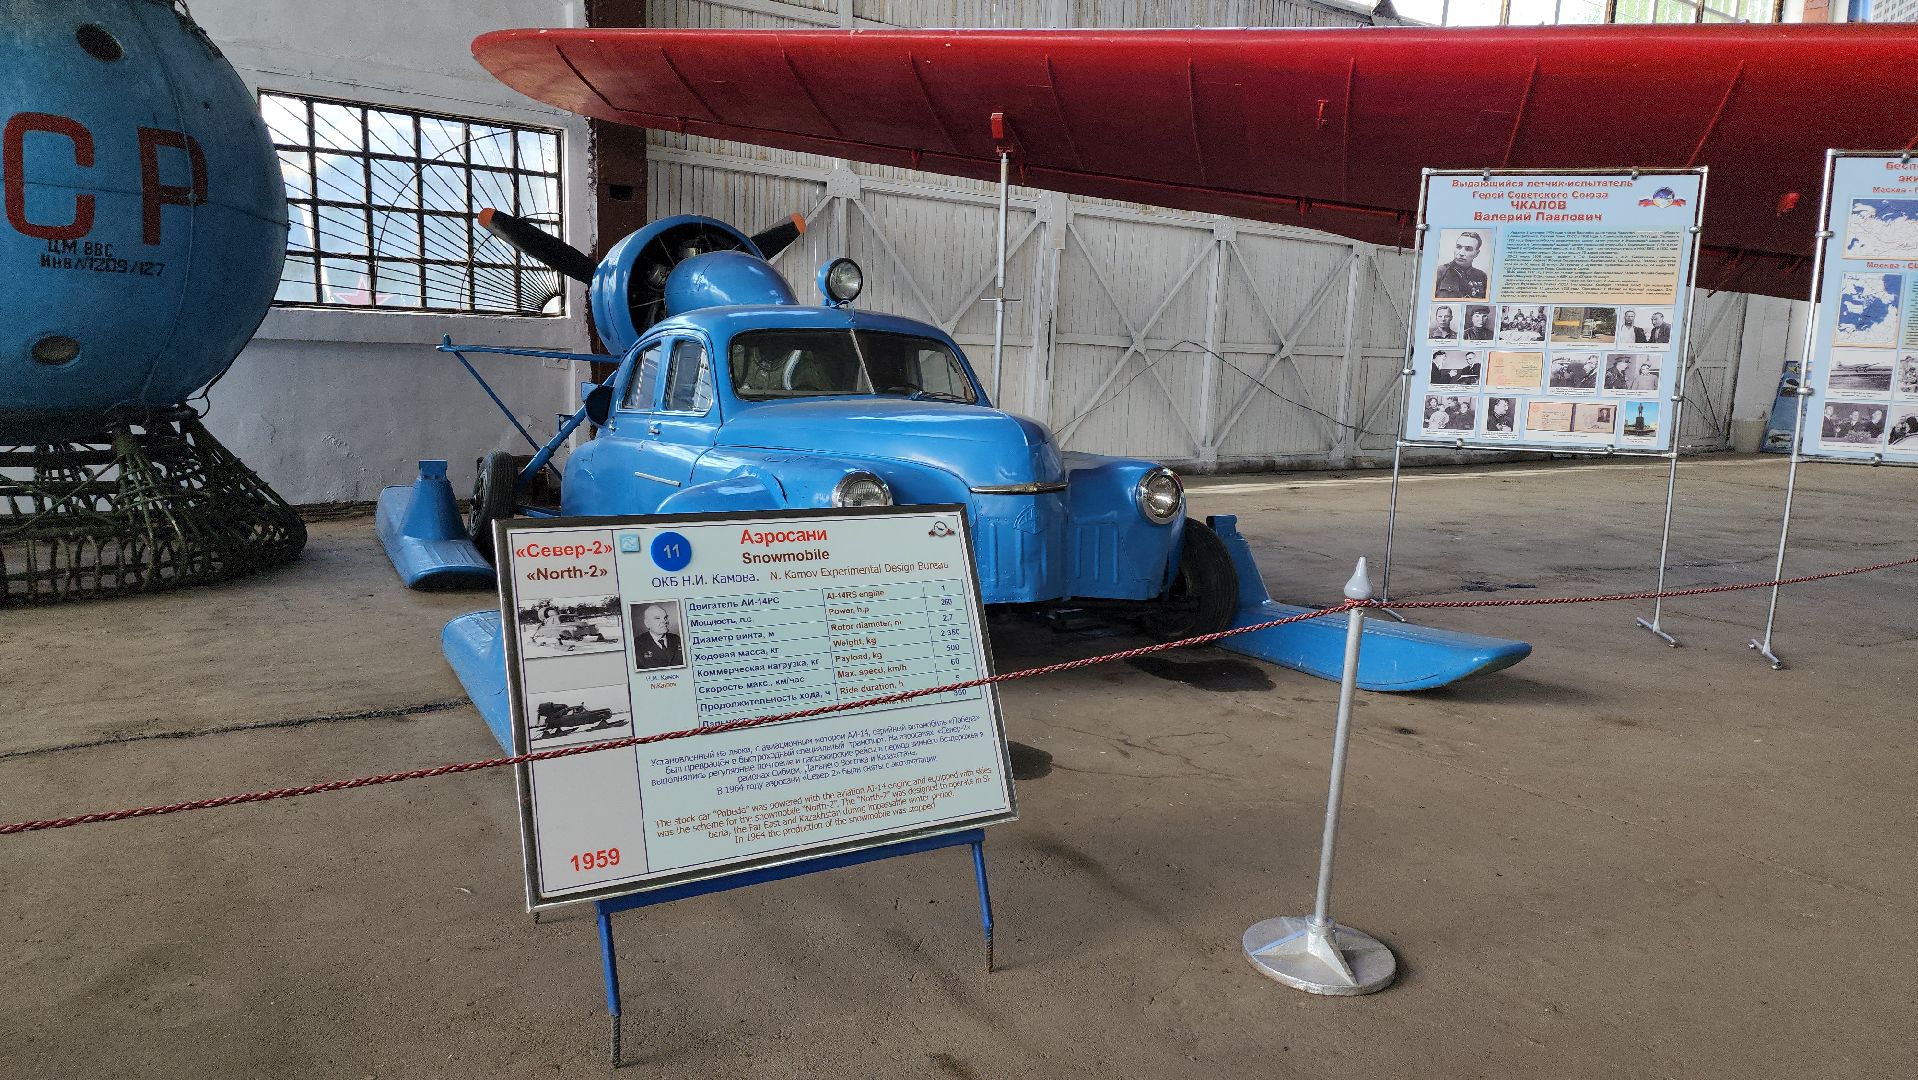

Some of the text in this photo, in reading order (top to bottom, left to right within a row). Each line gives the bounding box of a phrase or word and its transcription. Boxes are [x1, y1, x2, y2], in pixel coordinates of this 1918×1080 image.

[1452, 179, 1523, 188] Выдающийся
[1472, 190, 1608, 199] Герой Советского Союза
[1510, 200, 1567, 210] ЧКАЛОВ
[1473, 210, 1602, 223] Валерий Павлович
[740, 529, 828, 547] Аэросани
[515, 540, 613, 560] «Север-2»
[663, 543, 680, 559] 11
[742, 549, 830, 564] Snowmobile
[526, 564, 608, 581] «North-2»
[770, 561, 949, 581] N. Kamov Experimental Design Bureau
[651, 576, 678, 588] ОКБ
[712, 573, 760, 584] Камова.
[859, 589, 885, 599] engine
[689, 602, 739, 612] Двигатель
[690, 618, 738, 628] Мощность,
[830, 622, 854, 631] Rotor
[692, 634, 734, 645] Диаметр
[832, 636, 877, 648] Weight, kg
[694, 651, 736, 662] Ходовая
[834, 651, 883, 664] Payload, kg
[697, 664, 765, 678] Коммерческая
[810, 658, 820, 666] кг
[837, 670, 857, 679] Max.
[698, 683, 744, 694] Скорость
[840, 686, 859, 695] Ride
[860, 682, 897, 693] duration,
[700, 695, 798, 713] Продолжительность
[570, 848, 620, 871] 1959
